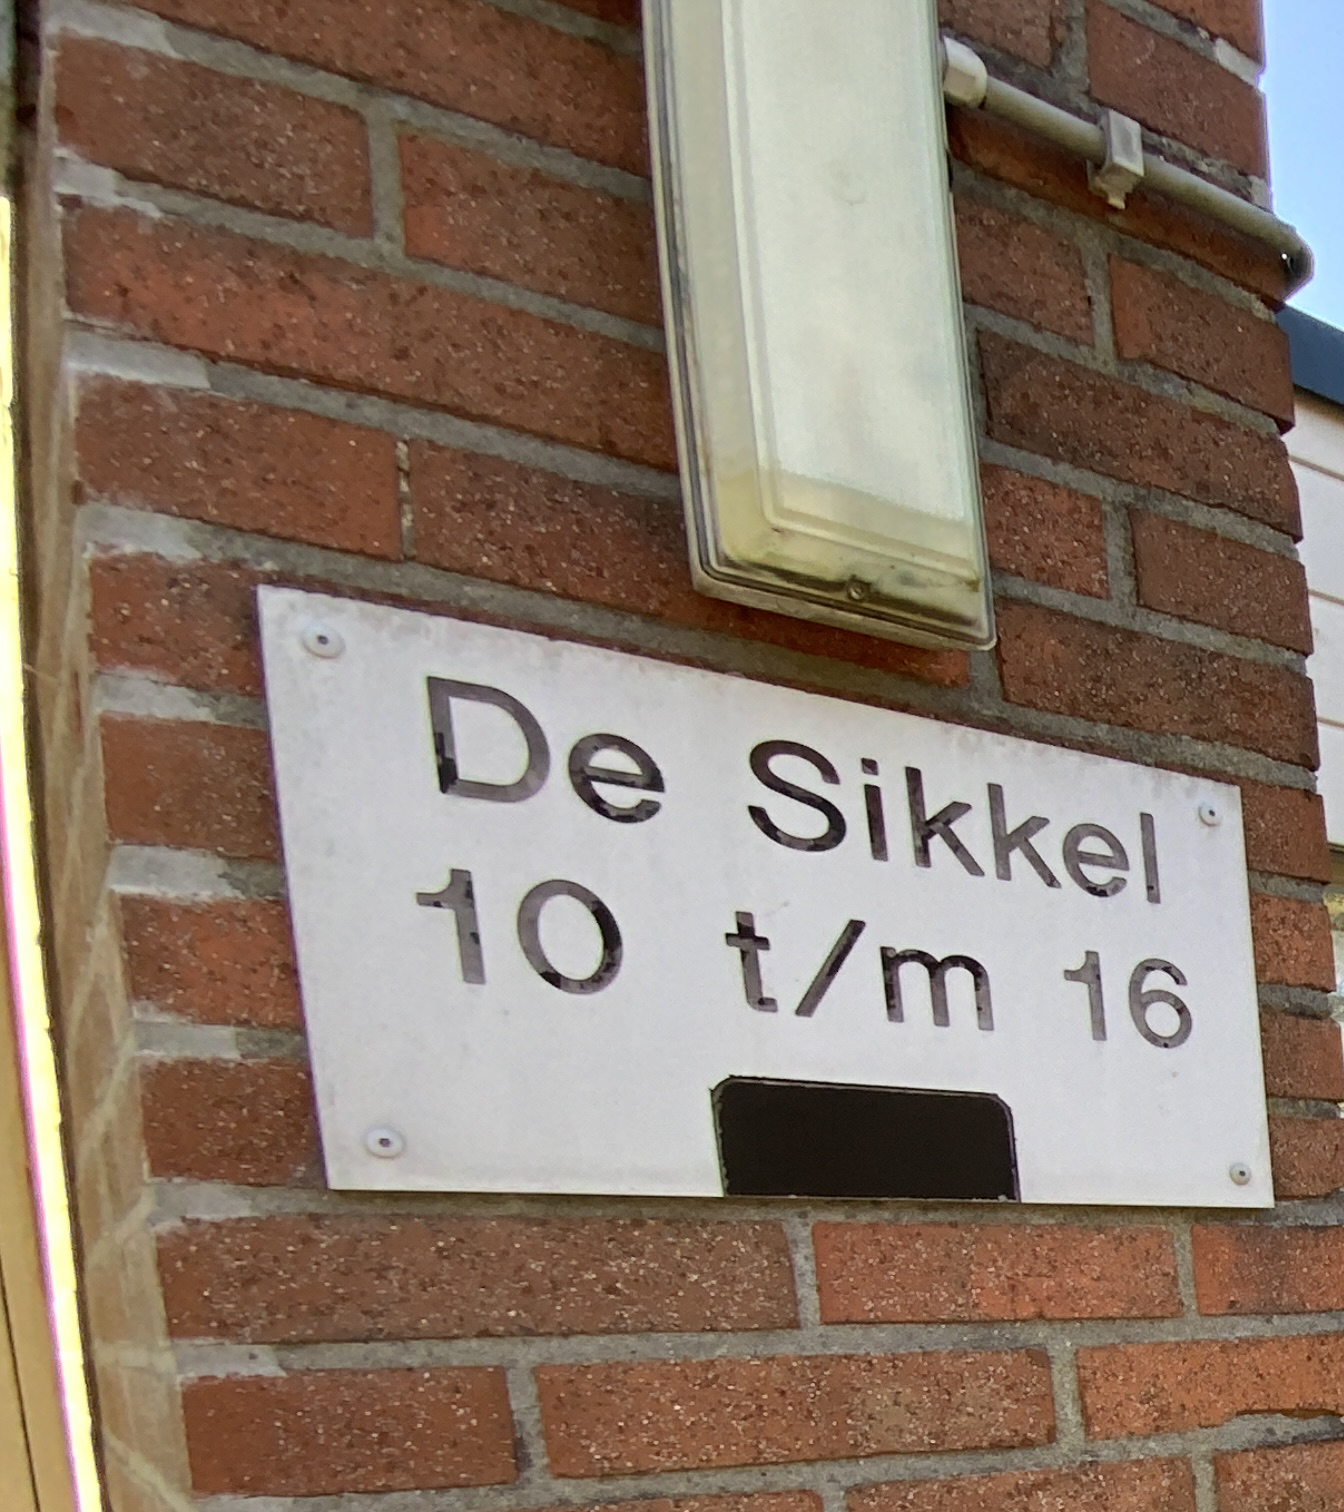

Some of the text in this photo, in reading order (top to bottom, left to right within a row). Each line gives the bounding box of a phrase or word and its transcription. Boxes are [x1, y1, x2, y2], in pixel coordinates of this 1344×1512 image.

[426, 675, 1161, 904] De Sikkel
[416, 868, 1193, 1049] 10 t/m 16
